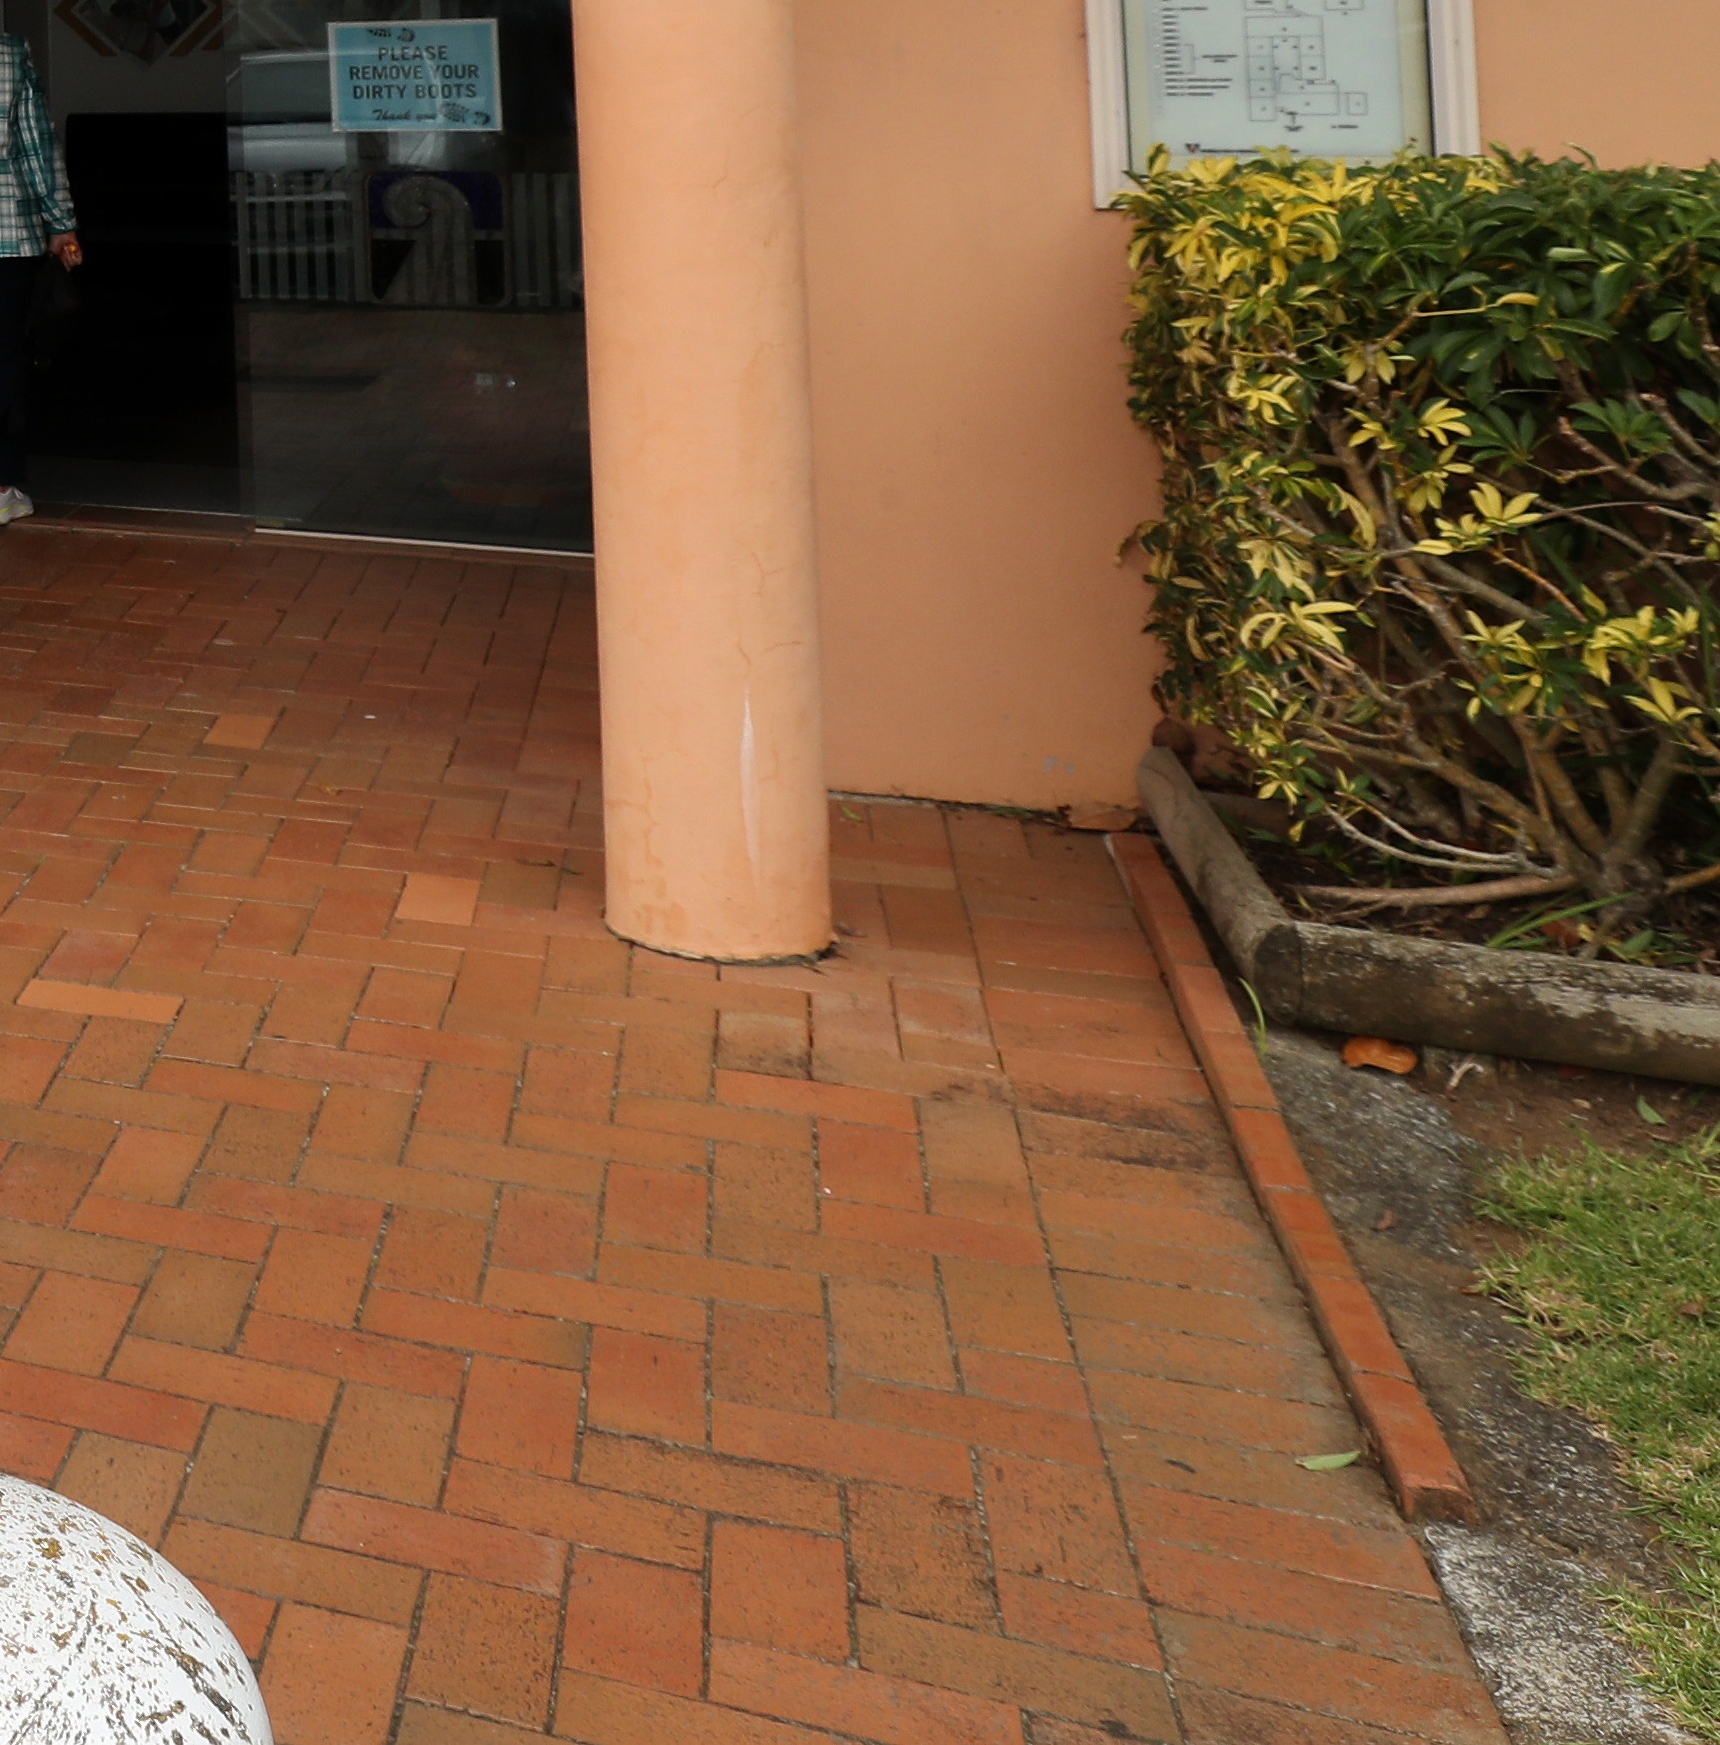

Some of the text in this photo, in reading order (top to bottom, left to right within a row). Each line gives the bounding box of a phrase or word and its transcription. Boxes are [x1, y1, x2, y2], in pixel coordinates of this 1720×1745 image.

[377, 45, 448, 61] PLEASE
[349, 64, 479, 80] REMOVE YOUR
[353, 84, 477, 99] DIRTY BOOTS
[371, 109, 410, 121] Thank
